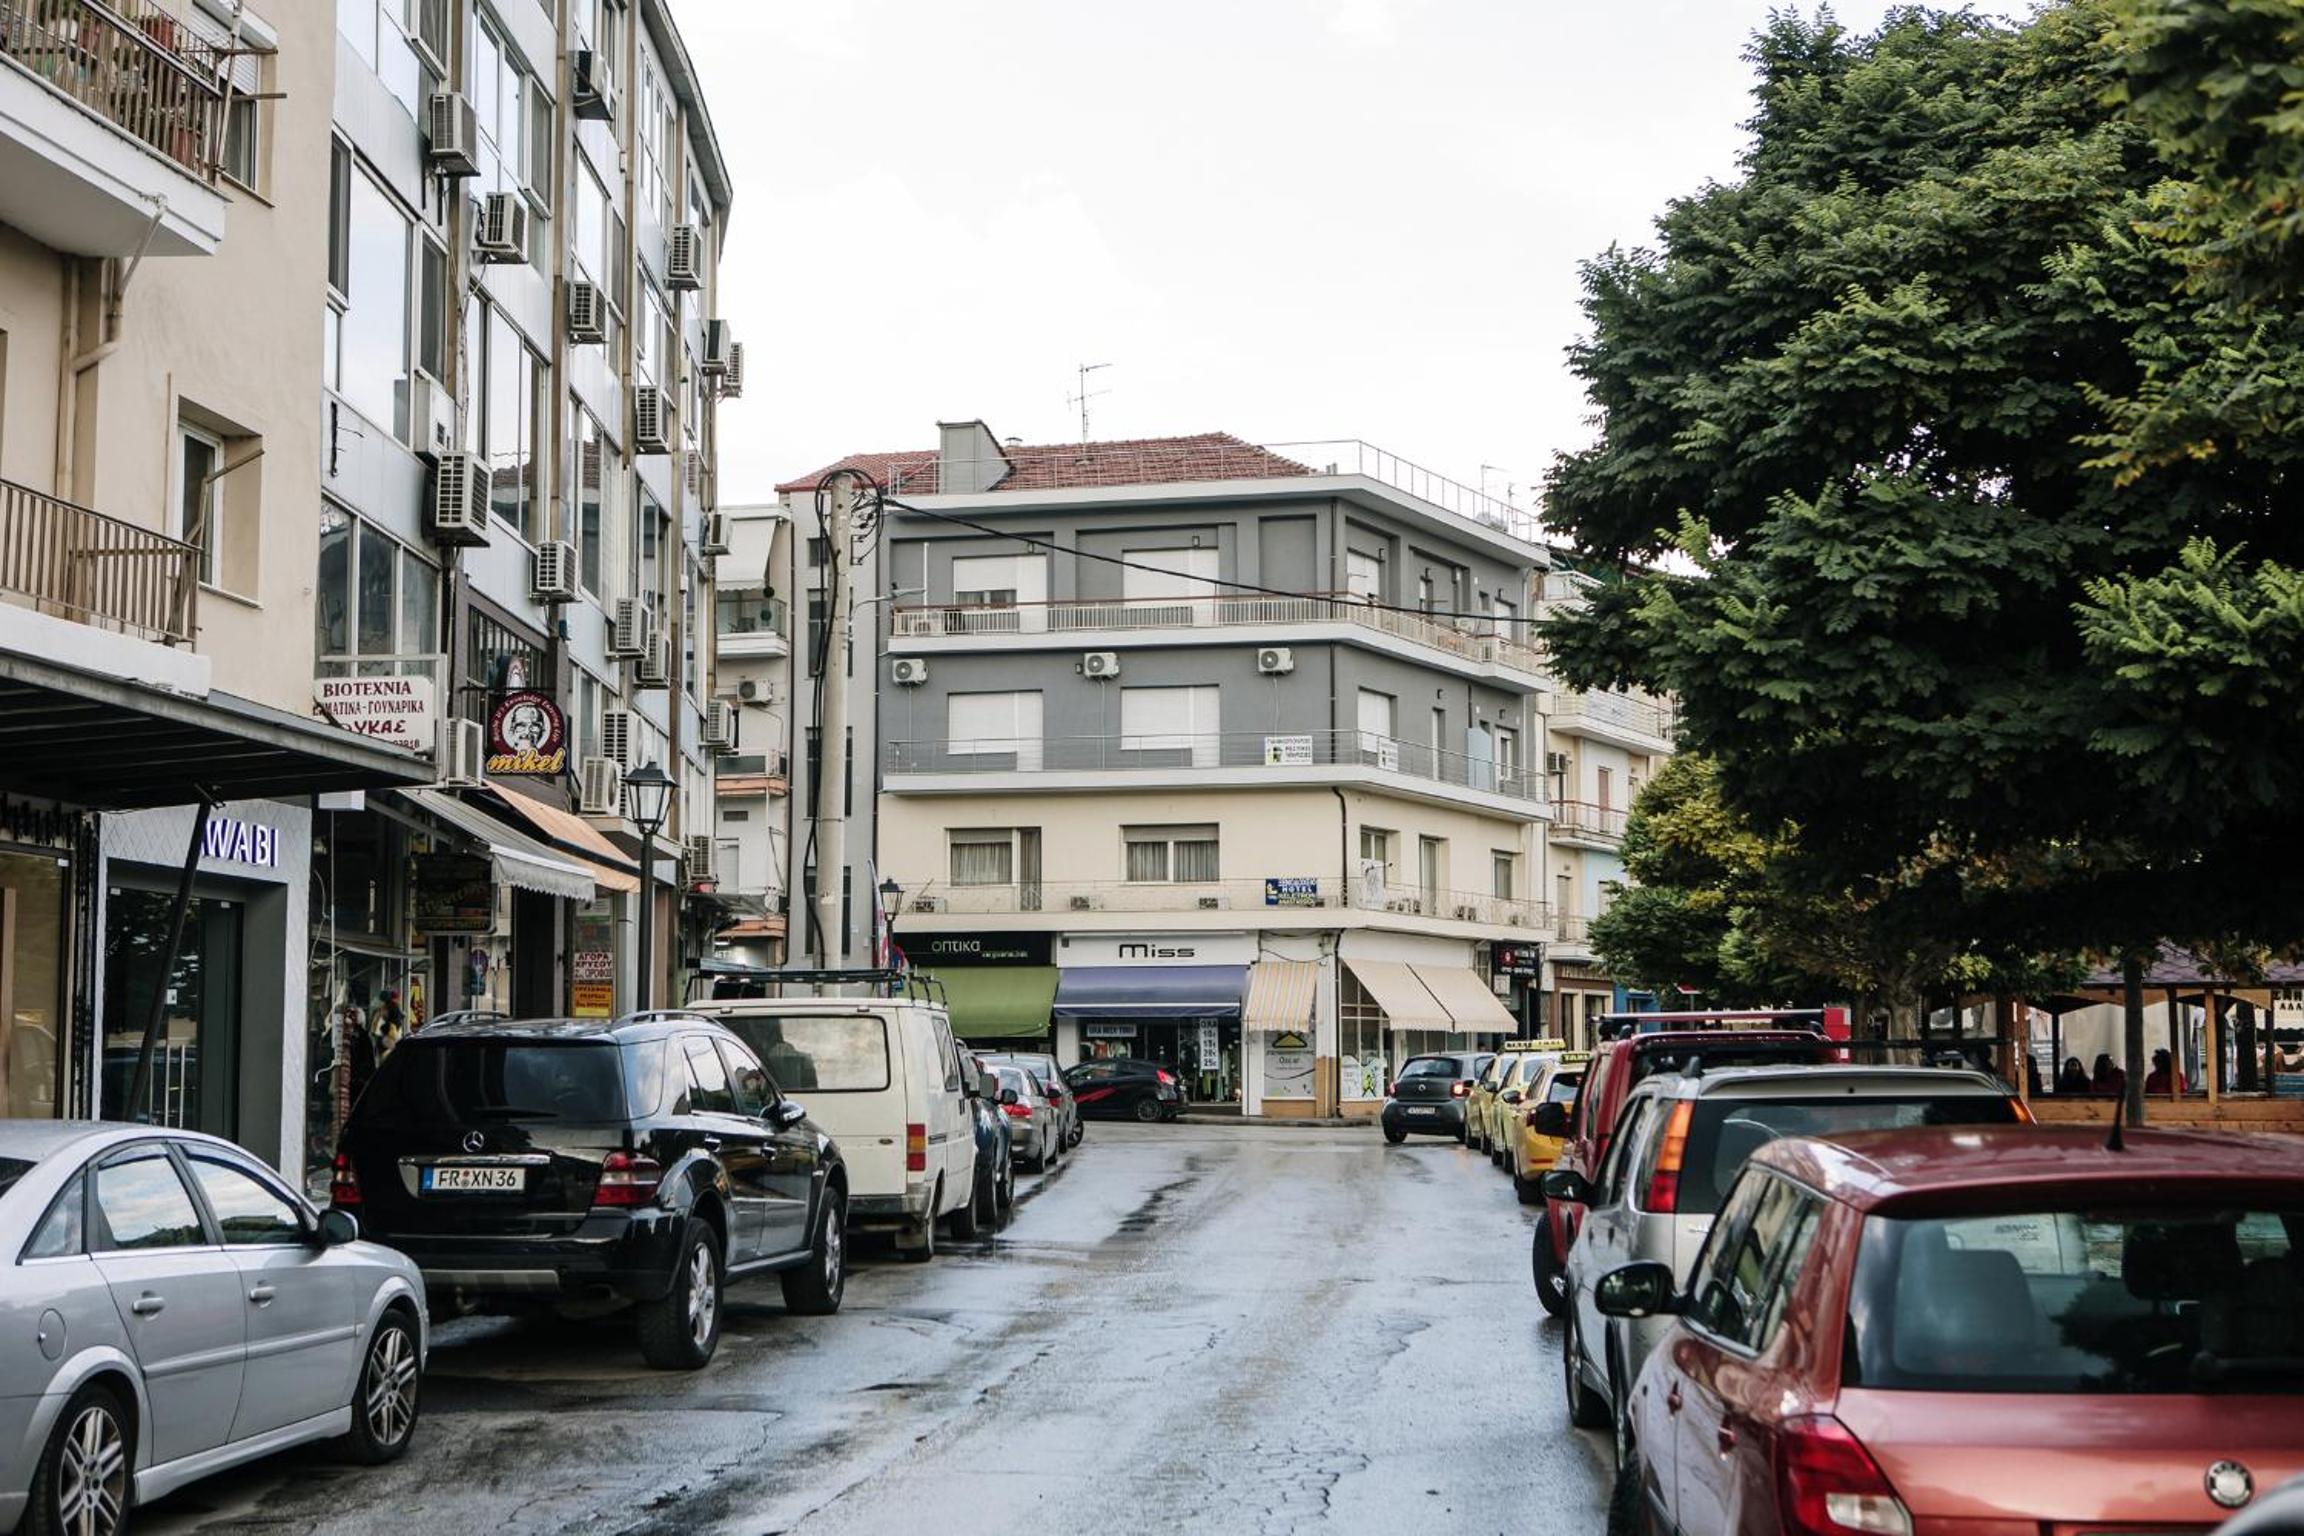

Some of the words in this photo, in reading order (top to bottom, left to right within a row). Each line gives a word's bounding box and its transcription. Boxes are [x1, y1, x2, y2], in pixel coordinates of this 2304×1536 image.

[323, 681, 412, 697] ΒΙΟΤΕΧΝΙΑ
[487, 747, 566, 774] mikel
[201, 818, 279, 867] WABI
[1282, 885, 1312, 893] HOTEL
[575, 961, 612, 969] ΧΡΥΣΟΥ
[578, 953, 609, 961] ΑΓΟΡΑ
[438, 1170, 459, 1187] FR
